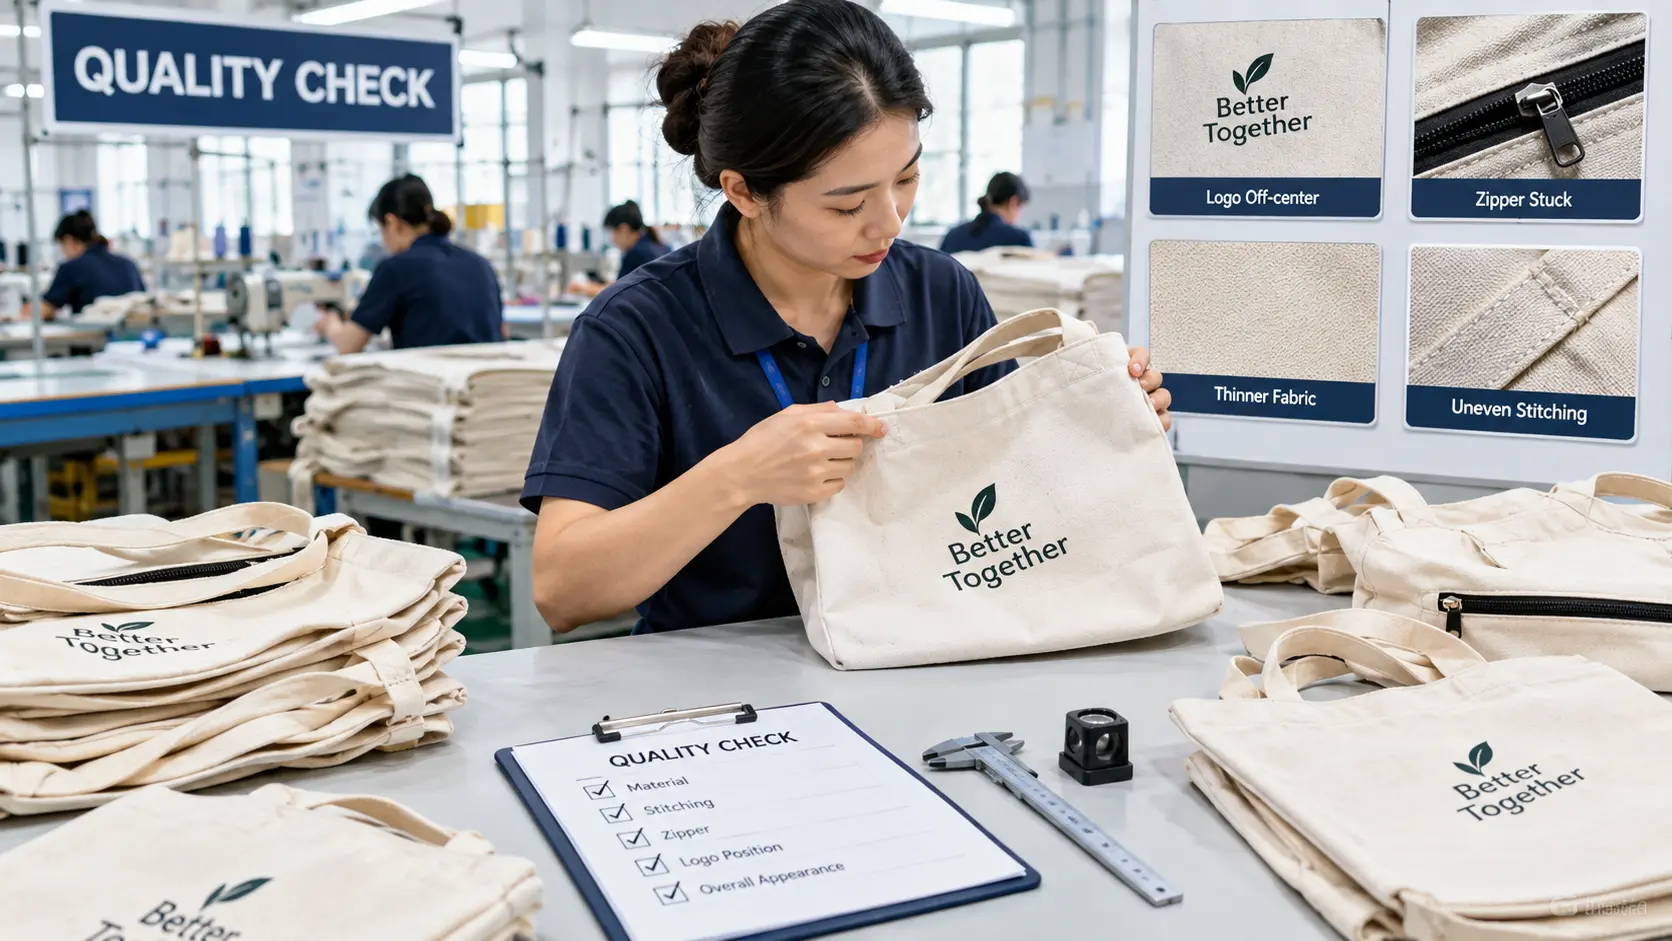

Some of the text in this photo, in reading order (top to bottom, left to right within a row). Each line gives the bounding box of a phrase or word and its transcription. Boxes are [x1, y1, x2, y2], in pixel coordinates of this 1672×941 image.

[74, 45, 436, 108] QUALITY CHECK
[1217, 92, 1288, 118] Better
[1203, 114, 1312, 146] Together
[1207, 189, 1319, 208] Logo Off-center
[1476, 191, 1572, 210] Zipper Stuck
[1214, 386, 1316, 405] Thinner Fabric
[1452, 399, 1587, 425] Uneven Stitching
[947, 522, 1031, 565] Better
[941, 536, 1068, 591] Together
[55, 636, 215, 661] Together
[73, 628, 179, 644] Better
[610, 731, 798, 767] QUALITY CHECK
[627, 777, 688, 791] Material
[1453, 764, 1541, 800] Better
[644, 800, 714, 814] Stitching
[1456, 768, 1586, 823] Together
[660, 825, 710, 842] Zipper
[680, 845, 783, 866] Logo Position
[700, 864, 844, 894] Overall Appearance
[139, 900, 242, 941] Better
